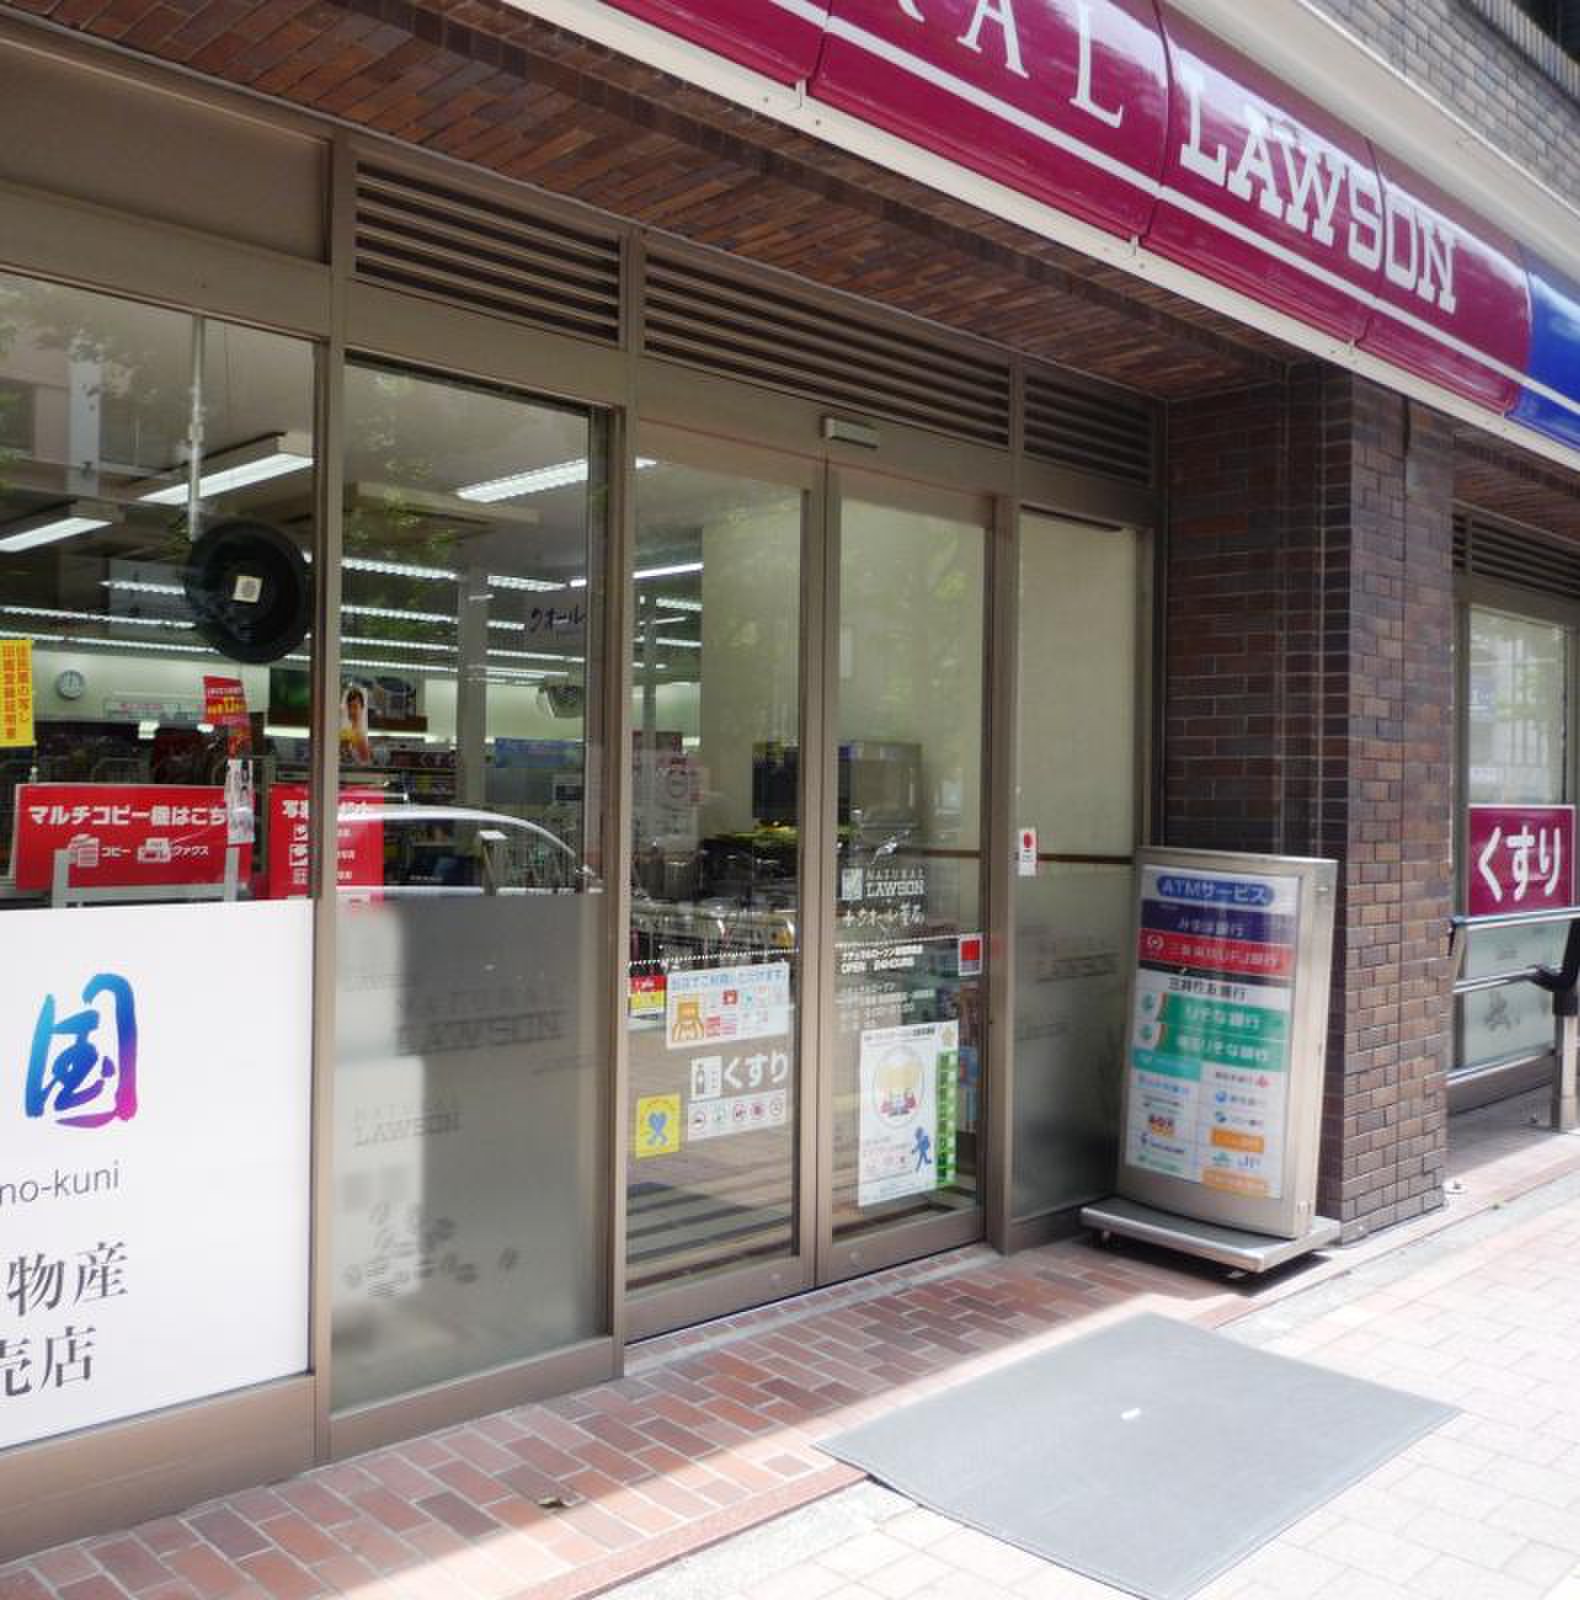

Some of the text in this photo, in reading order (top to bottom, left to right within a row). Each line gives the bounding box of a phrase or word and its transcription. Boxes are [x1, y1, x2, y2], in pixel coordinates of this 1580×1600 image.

[898, 0, 1458, 314] AL LAWSON
[29, 805, 227, 825] マルチコピー機はこち
[866, 880, 925, 897] LAWSON
[1161, 878, 1267, 902] ATMサービス
[1478, 827, 1561, 901] くすり
[24, 973, 138, 1129] 国
[723, 1050, 789, 1088] くすり
[7, 1241, 129, 1317] 物産
